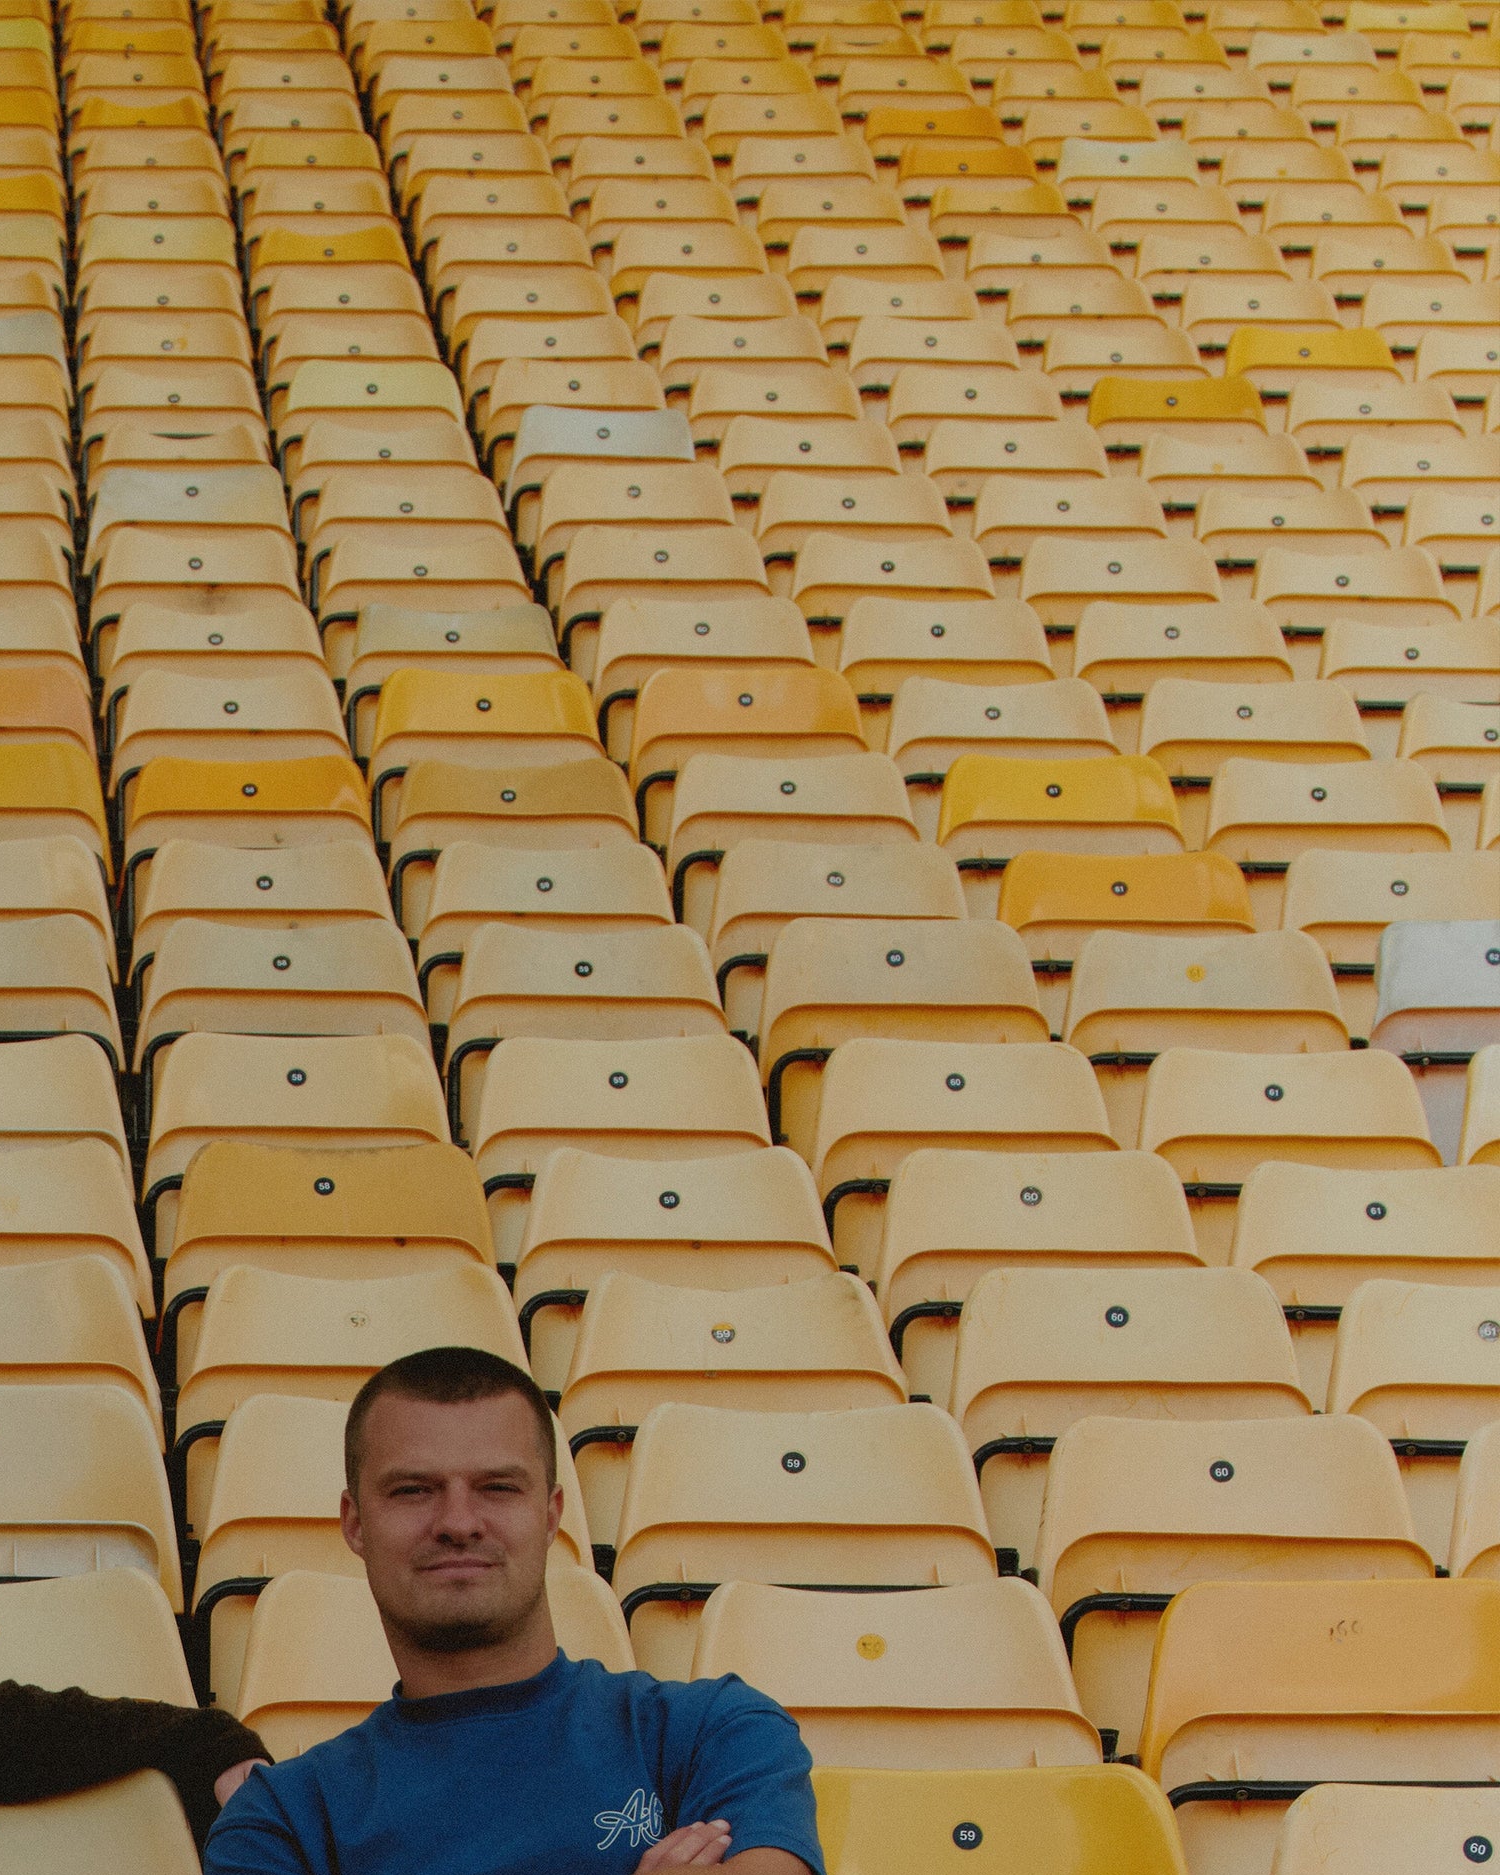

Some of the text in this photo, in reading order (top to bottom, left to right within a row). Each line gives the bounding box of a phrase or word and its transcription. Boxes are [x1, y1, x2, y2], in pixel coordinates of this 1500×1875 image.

[613, 1076, 624, 1084] 59
[319, 1182, 330, 1190] 58
[664, 1196, 675, 1204] 59
[1024, 1192, 1038, 1202] 60
[1370, 1207, 1381, 1215] 61
[1111, 1313, 1123, 1322] 60
[716, 1329, 731, 1338] 59
[1484, 1327, 1496, 1336] 61
[787, 1459, 800, 1468] 59
[1215, 1468, 1228, 1477] 60
[960, 1830, 975, 1841] 59
[1470, 1843, 1486, 1855] 60
